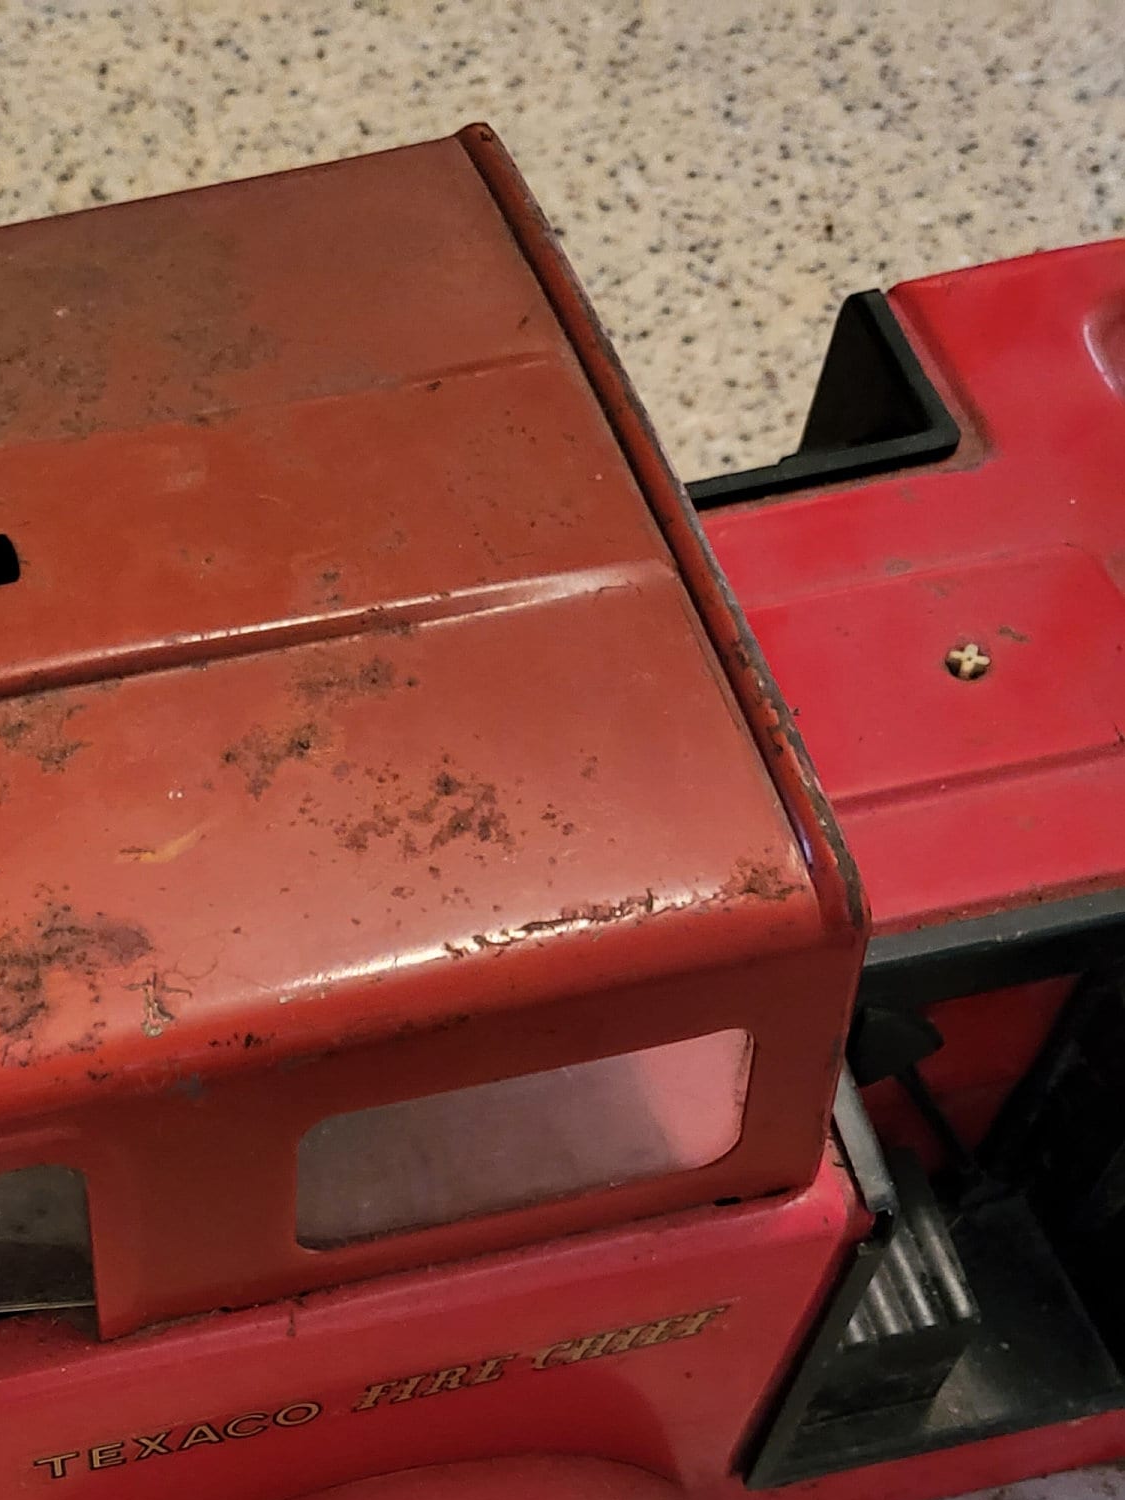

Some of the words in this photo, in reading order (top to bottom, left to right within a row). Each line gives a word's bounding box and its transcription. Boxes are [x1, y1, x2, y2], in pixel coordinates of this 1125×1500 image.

[34, 1402, 322, 1479] TEXACO
[353, 1353, 518, 1412] FIRE
[531, 1304, 731, 1371] CHIEF
